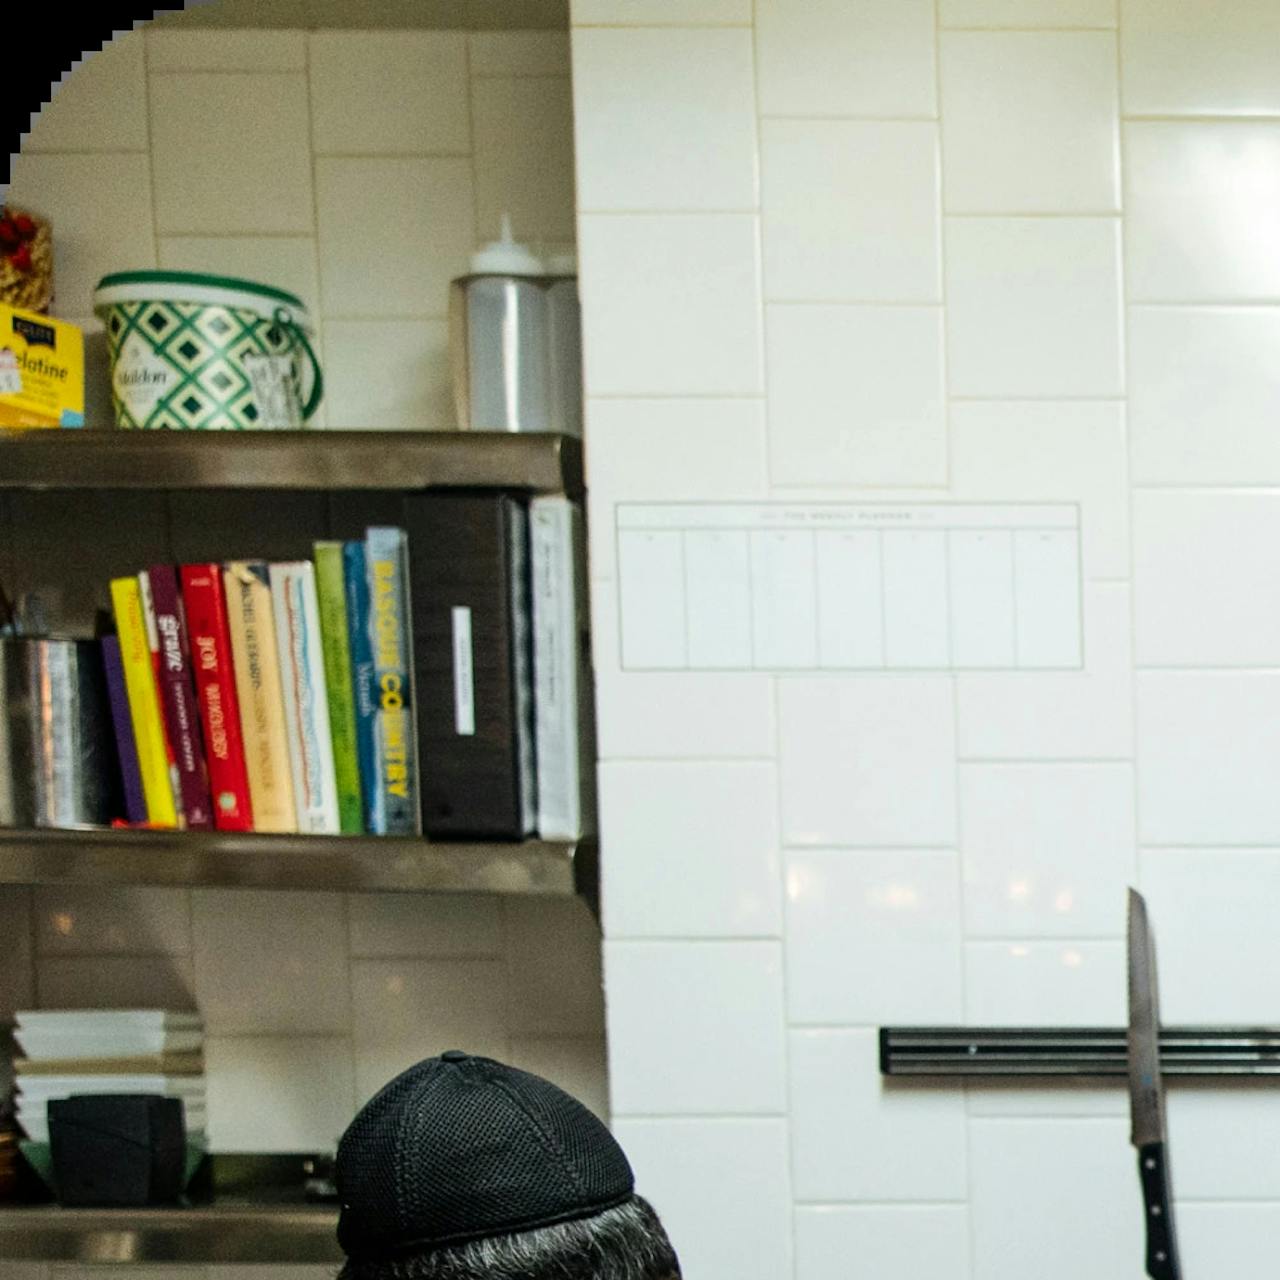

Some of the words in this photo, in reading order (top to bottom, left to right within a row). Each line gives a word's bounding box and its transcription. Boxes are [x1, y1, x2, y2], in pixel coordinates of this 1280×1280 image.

[14, 349, 68, 382] elatine
[373, 560, 398, 665] BASQUE
[197, 636, 218, 671] JOY
[380, 672, 407, 797] COUNTRY
